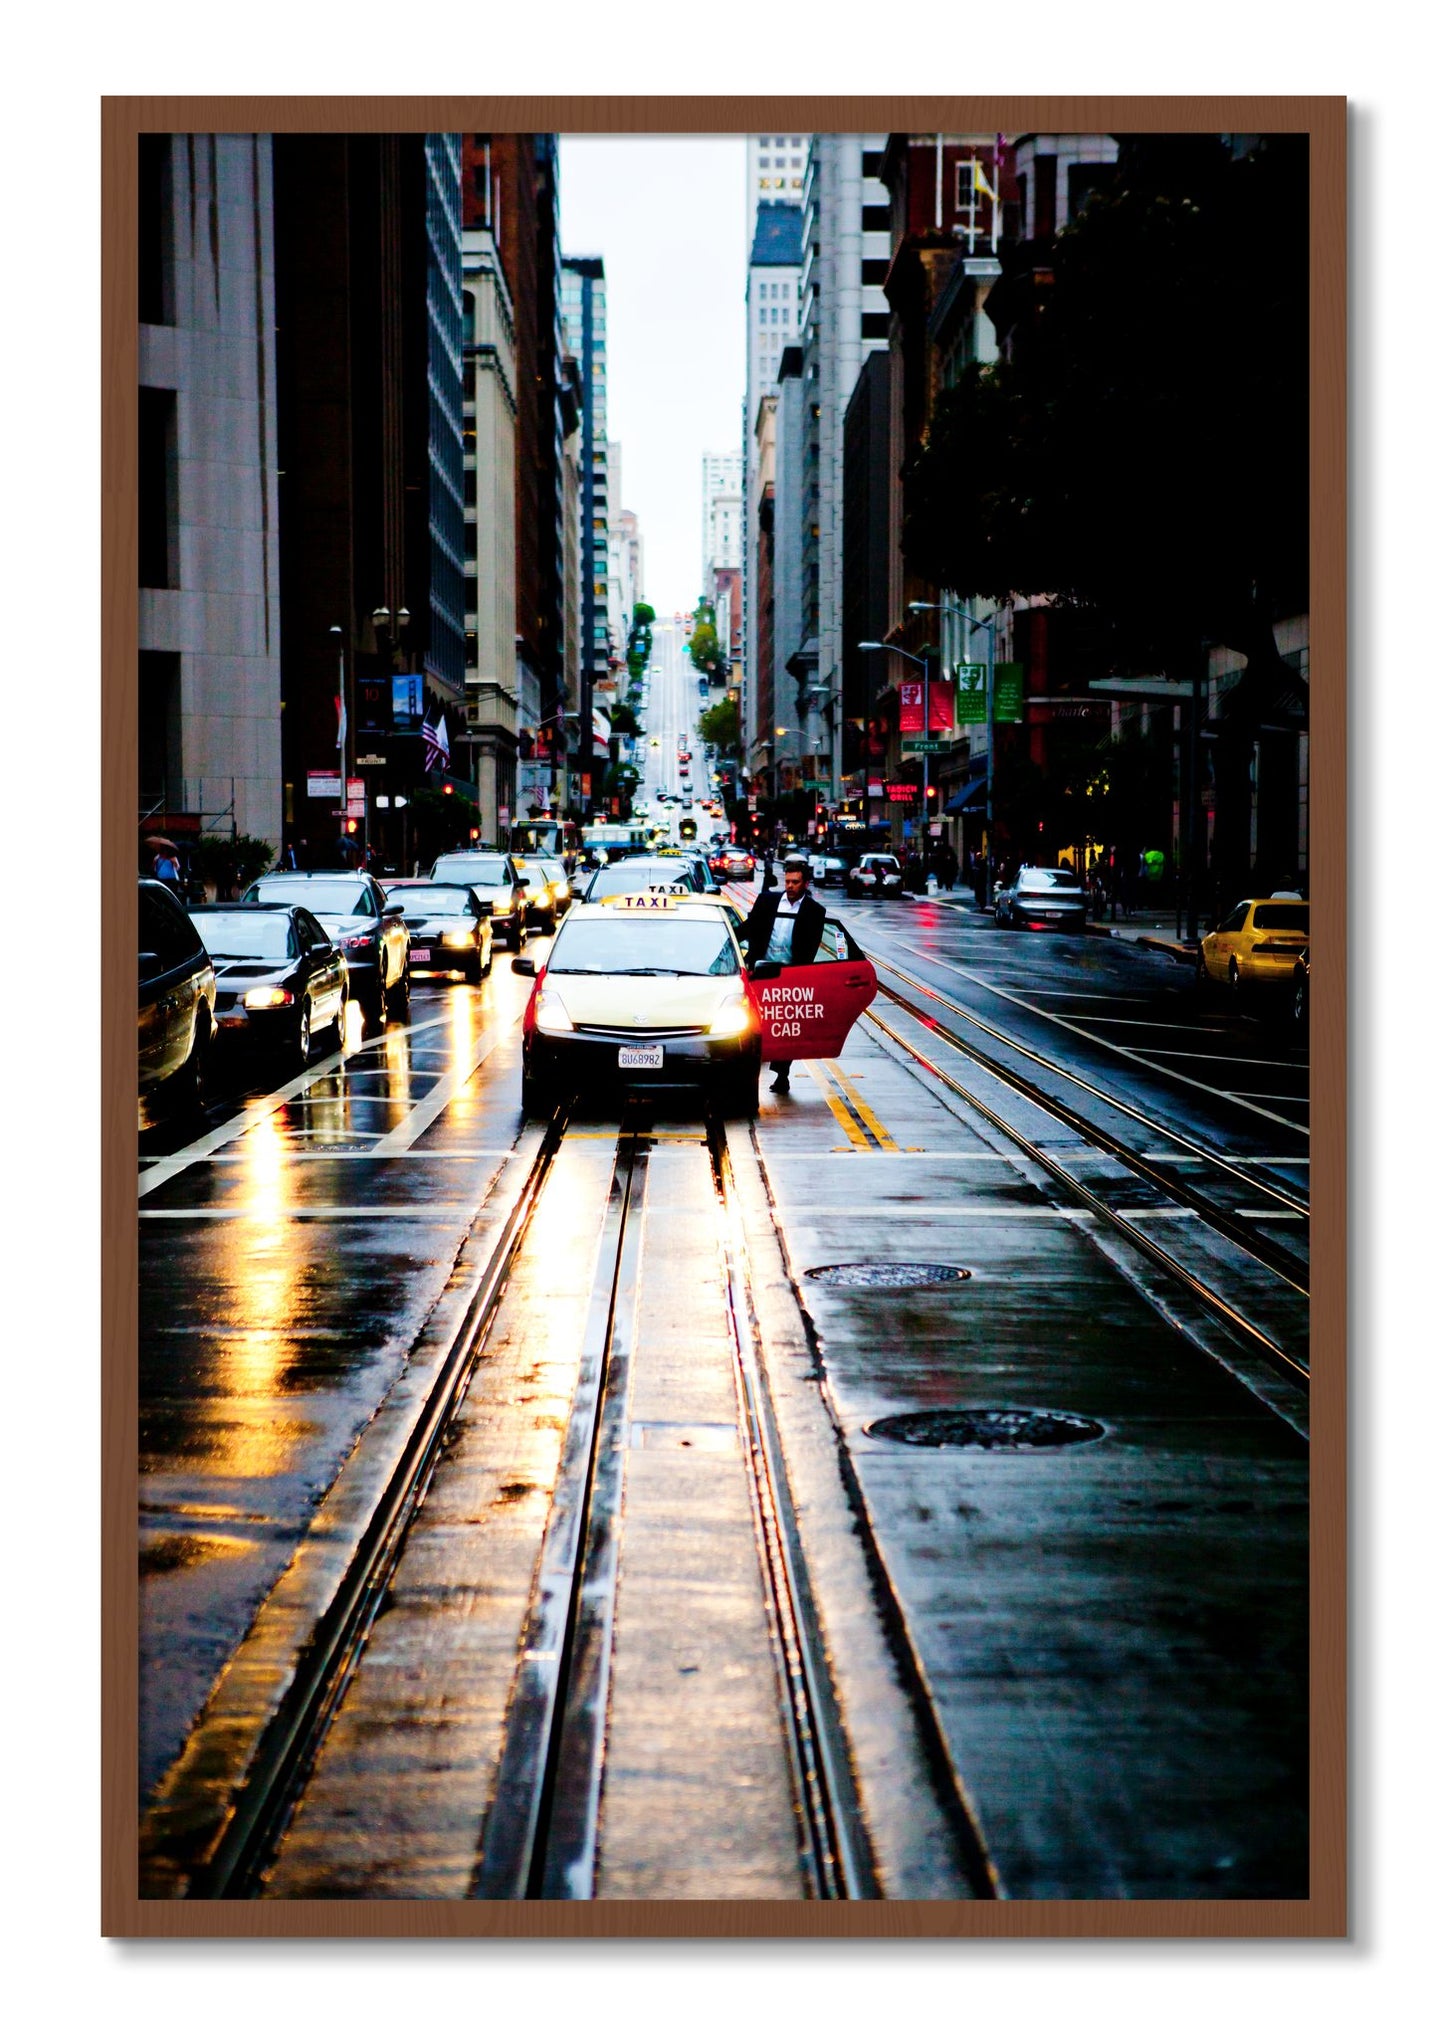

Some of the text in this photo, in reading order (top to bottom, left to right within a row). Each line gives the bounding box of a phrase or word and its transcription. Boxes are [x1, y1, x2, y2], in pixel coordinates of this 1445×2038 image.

[914, 742, 939, 750] Front
[649, 886, 683, 894] TAXI
[625, 897, 667, 907] TAXI
[761, 987, 814, 1003] ARROW
[771, 1022, 801, 1037] CAB
